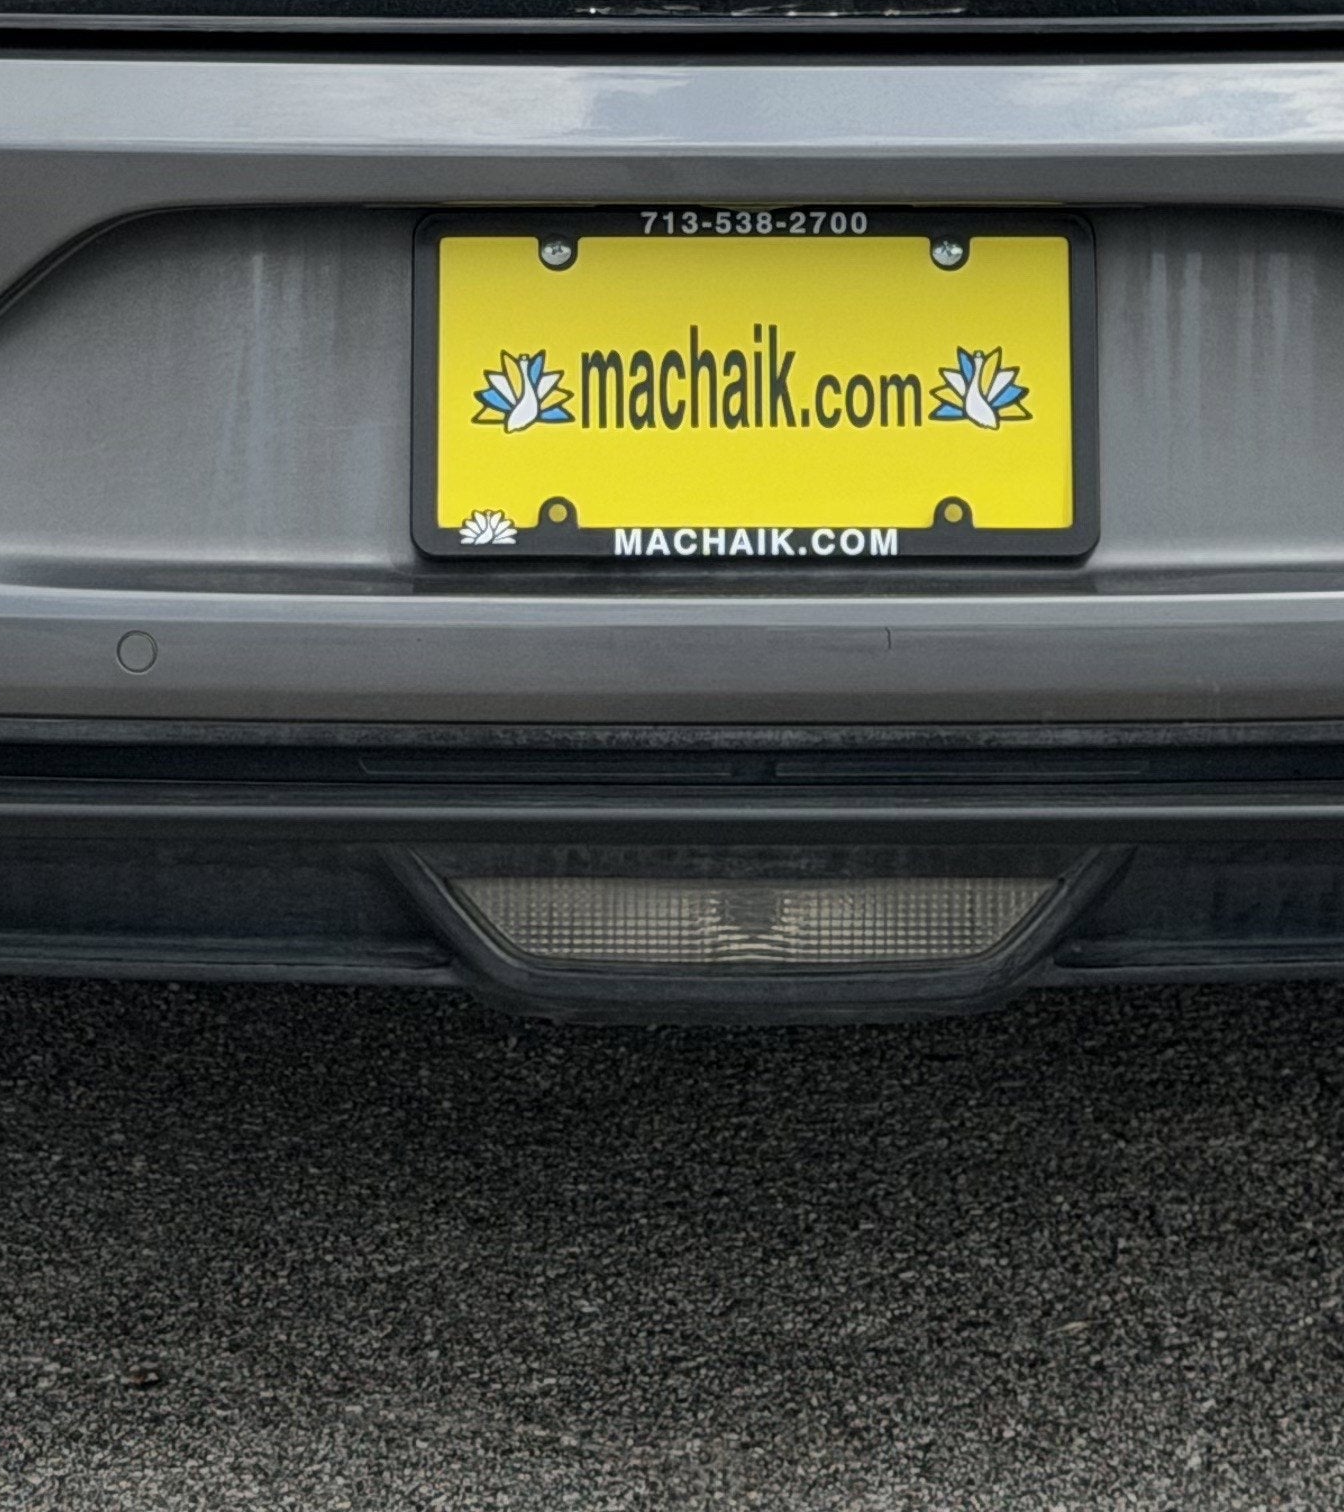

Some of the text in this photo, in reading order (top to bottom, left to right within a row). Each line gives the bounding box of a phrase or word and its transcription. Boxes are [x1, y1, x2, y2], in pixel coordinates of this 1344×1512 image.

[640, 211, 869, 235] 713-538-2700
[581, 323, 922, 429] machaik.com
[613, 528, 899, 556] MACHAIK.COM
